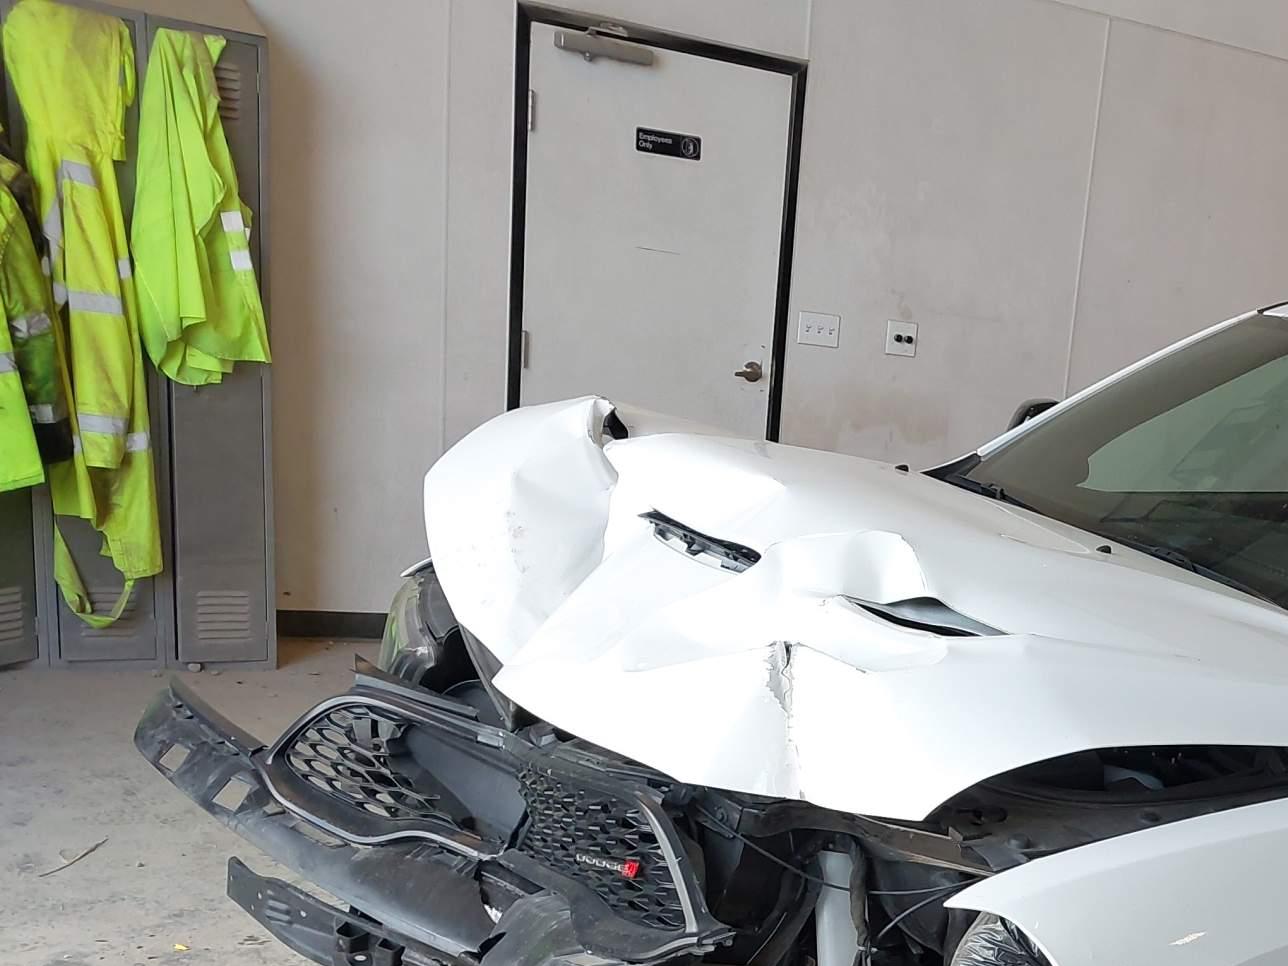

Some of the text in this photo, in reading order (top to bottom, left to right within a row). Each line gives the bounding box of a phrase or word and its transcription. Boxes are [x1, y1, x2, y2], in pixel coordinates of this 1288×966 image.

[638, 132, 673, 144] Employees
[638, 140, 653, 151] Only
[575, 853, 625, 872] DODGE
